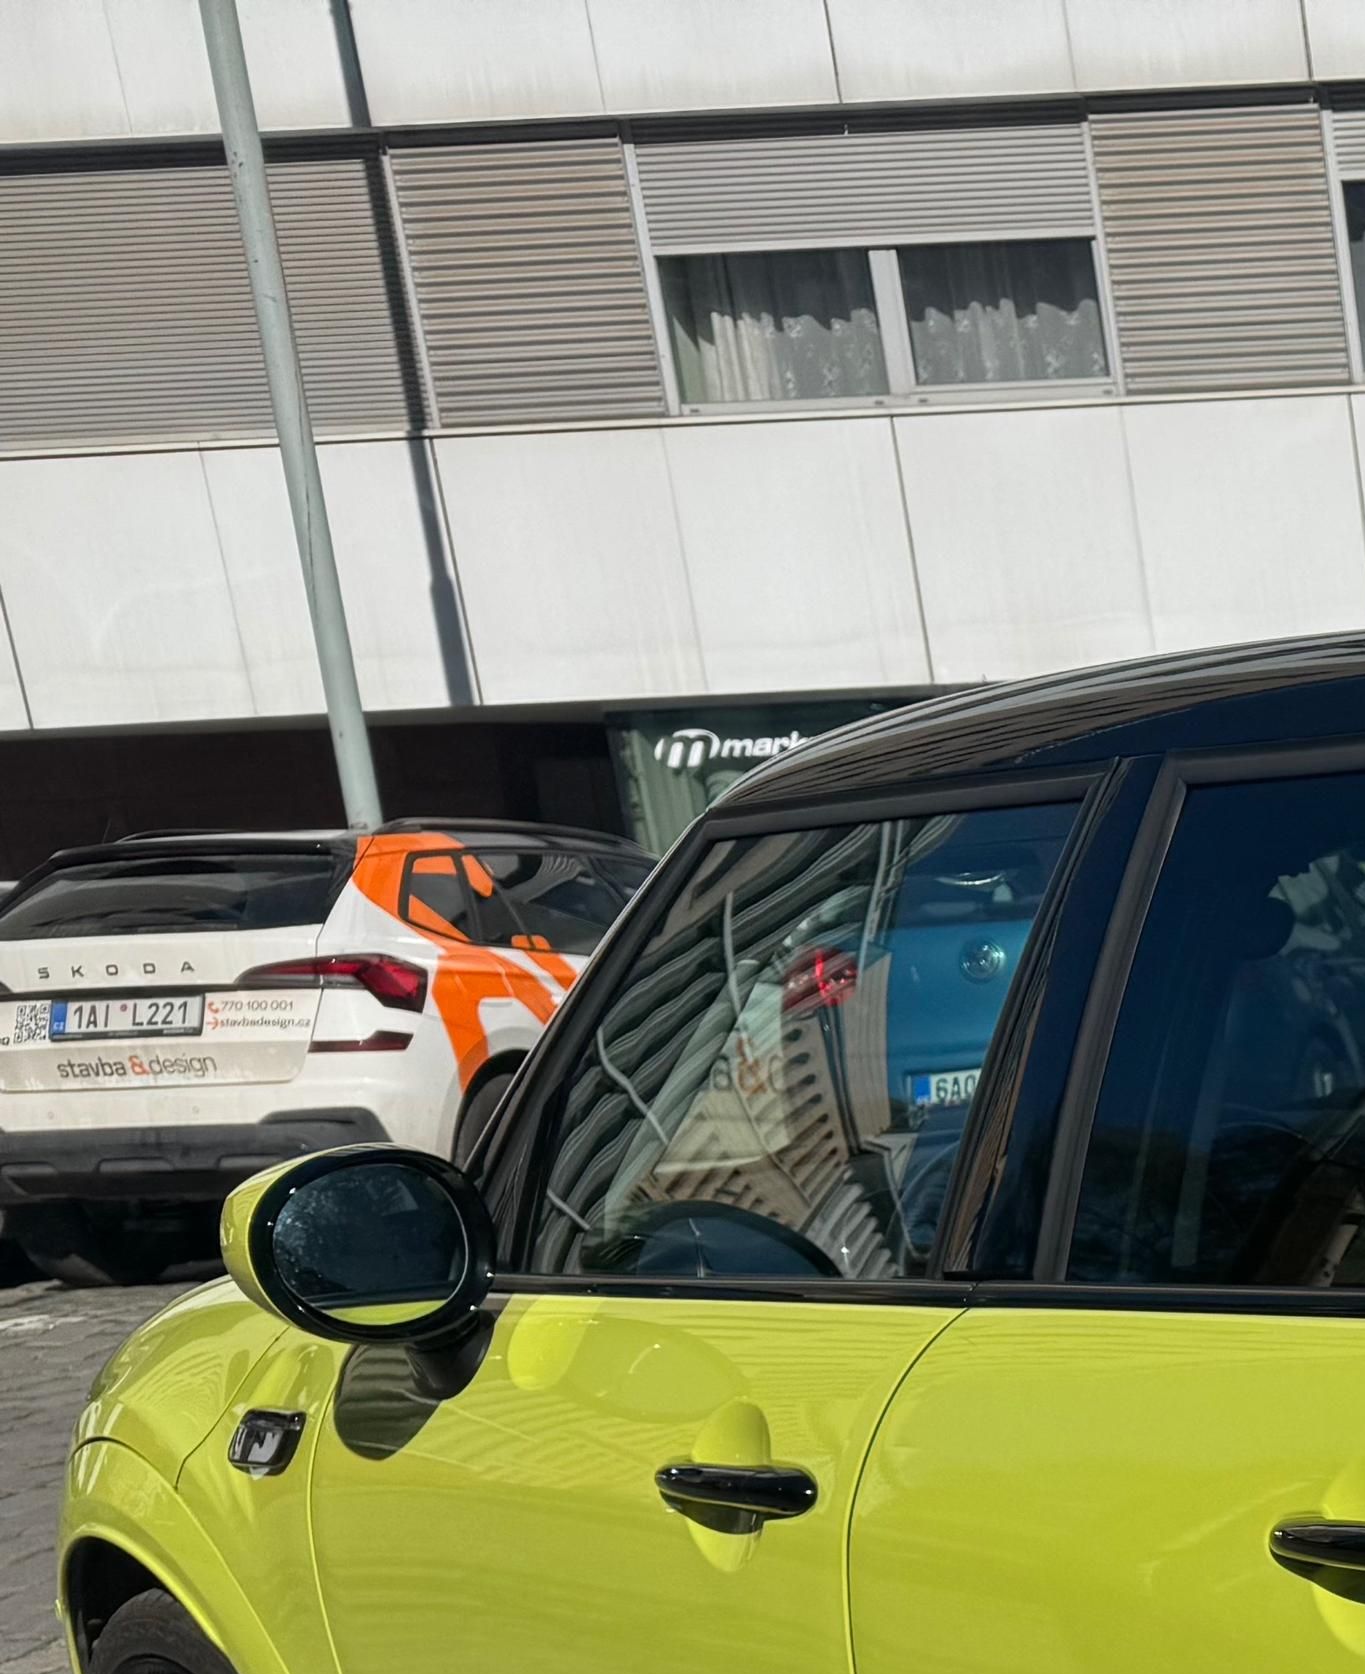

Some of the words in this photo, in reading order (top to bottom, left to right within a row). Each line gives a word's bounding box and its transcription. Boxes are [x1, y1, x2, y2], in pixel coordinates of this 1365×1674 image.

[720, 730, 814, 757] mark
[73, 1004, 110, 1030] 1AI
[132, 1001, 188, 1027] L221
[246, 1000, 268, 1011] 100
